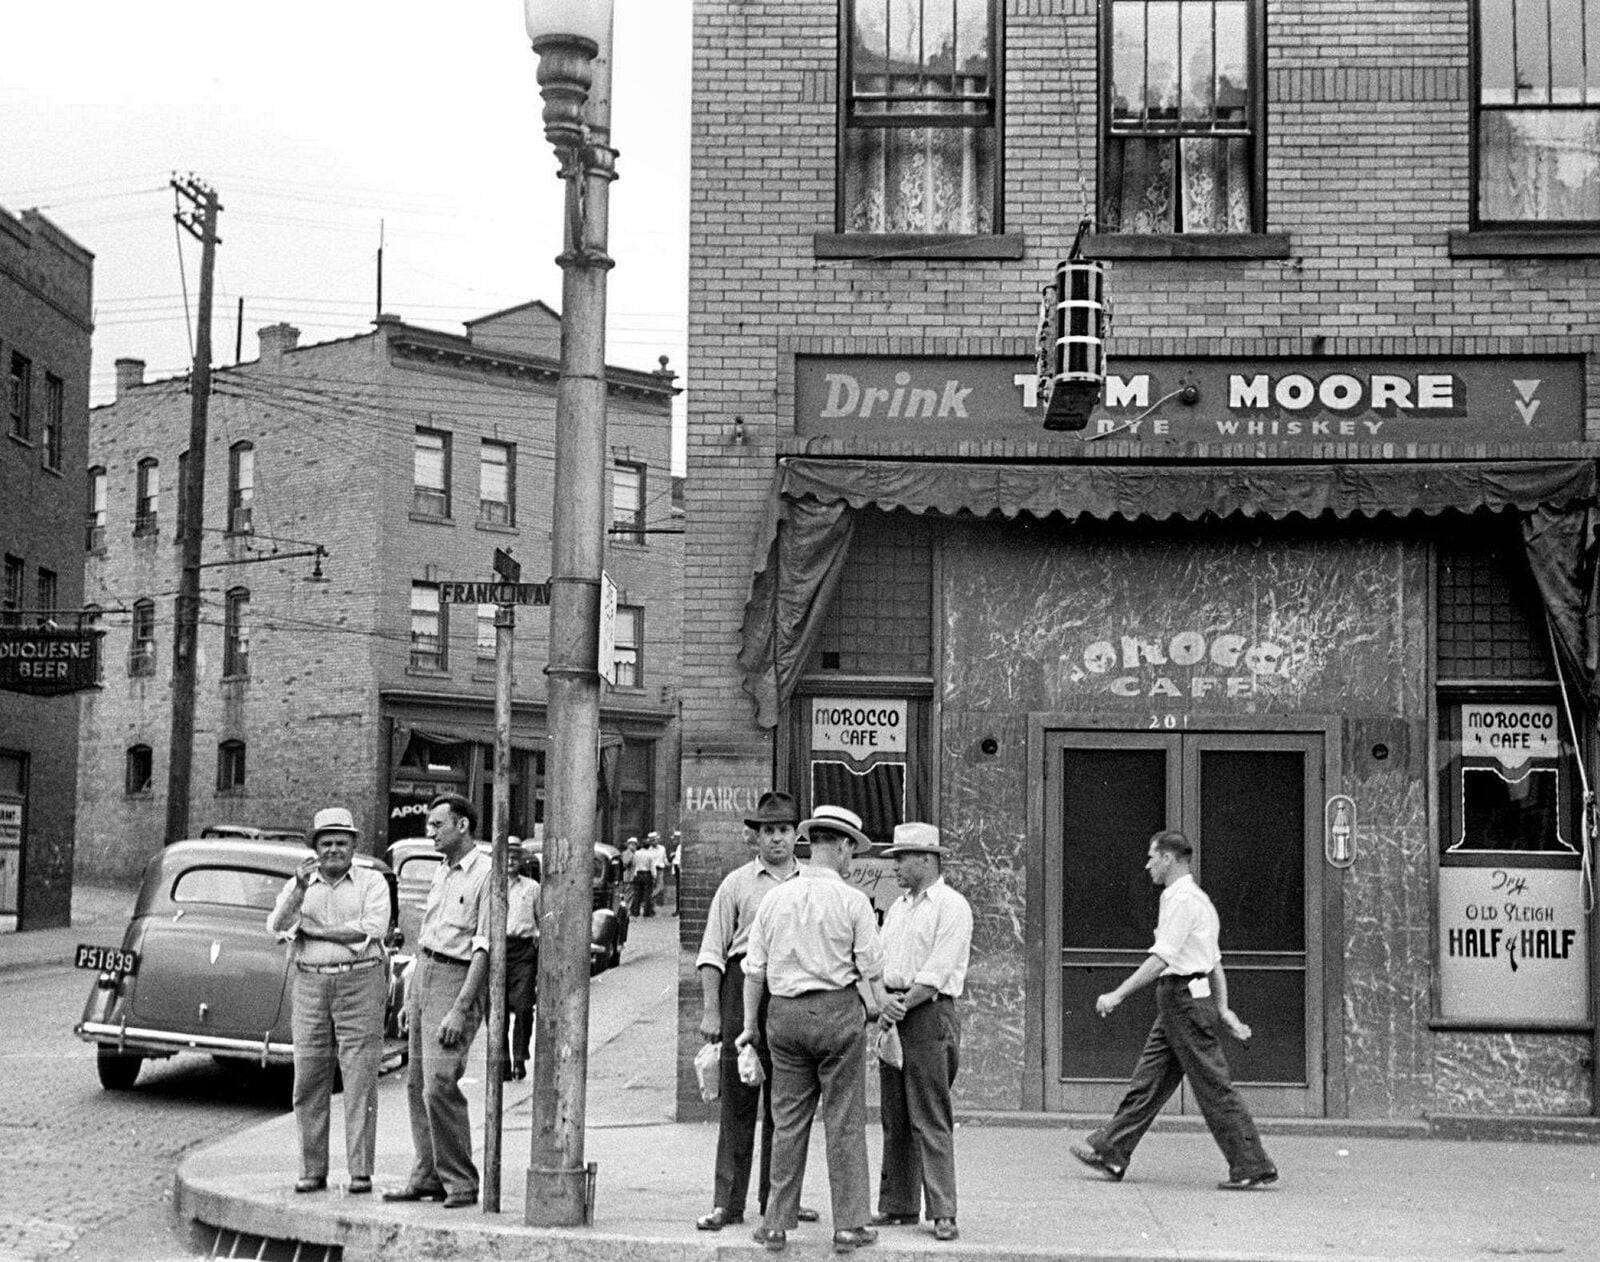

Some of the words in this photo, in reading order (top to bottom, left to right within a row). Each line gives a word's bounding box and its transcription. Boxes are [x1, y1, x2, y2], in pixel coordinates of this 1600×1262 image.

[820, 371, 974, 418] Drink
[1014, 374, 1150, 408] TM
[1229, 374, 1454, 410] MOORE
[1097, 419, 1170, 435] RYE
[1216, 420, 1384, 435] WHISKEY
[442, 583, 528, 604] FRANKLIN
[0, 642, 91, 658] DUQUESNE
[20, 661, 68, 678] BEER
[1110, 676, 1257, 697] CAFE
[815, 708, 900, 728] MOROCCO
[1149, 714, 1188, 729] 201
[1468, 711, 1553, 729] MOROCCO
[840, 730, 878, 747] CAFE
[1490, 732, 1532, 749] CAFE
[686, 786, 768, 812] HAIRCU
[840, 865, 898, 890] njoy
[1466, 904, 1498, 920] OLD
[1504, 902, 1554, 921] SLEIGH
[1449, 928, 1503, 957] HALF
[1521, 929, 1576, 959] HALF
[78, 948, 133, 972] P51839
